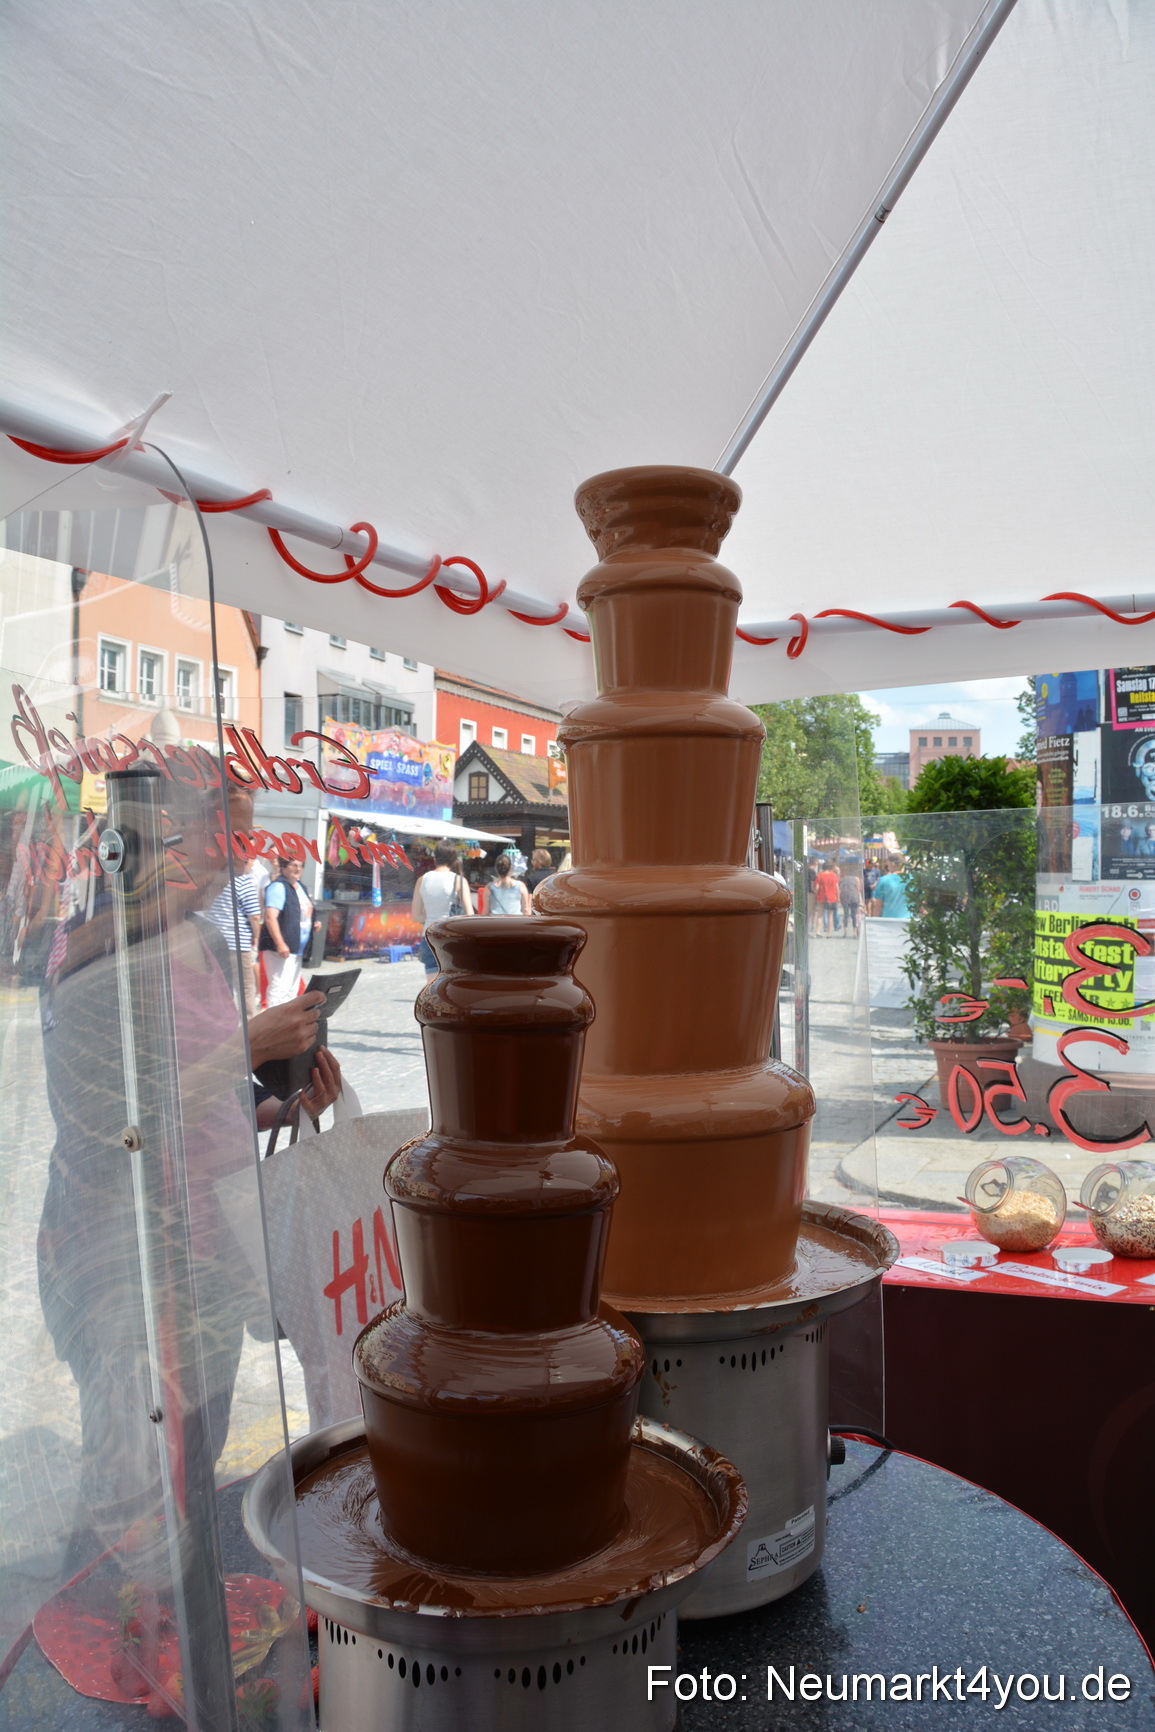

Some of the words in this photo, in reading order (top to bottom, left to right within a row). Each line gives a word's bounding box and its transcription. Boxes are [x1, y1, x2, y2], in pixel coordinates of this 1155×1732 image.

[1049, 735, 1070, 749] Fietz
[369, 758, 392, 771] SPIEL
[396, 761, 420, 776] SPASS
[1101, 804, 1144, 819] 18.6.
[750, 1552, 779, 1567] SEPHRA
